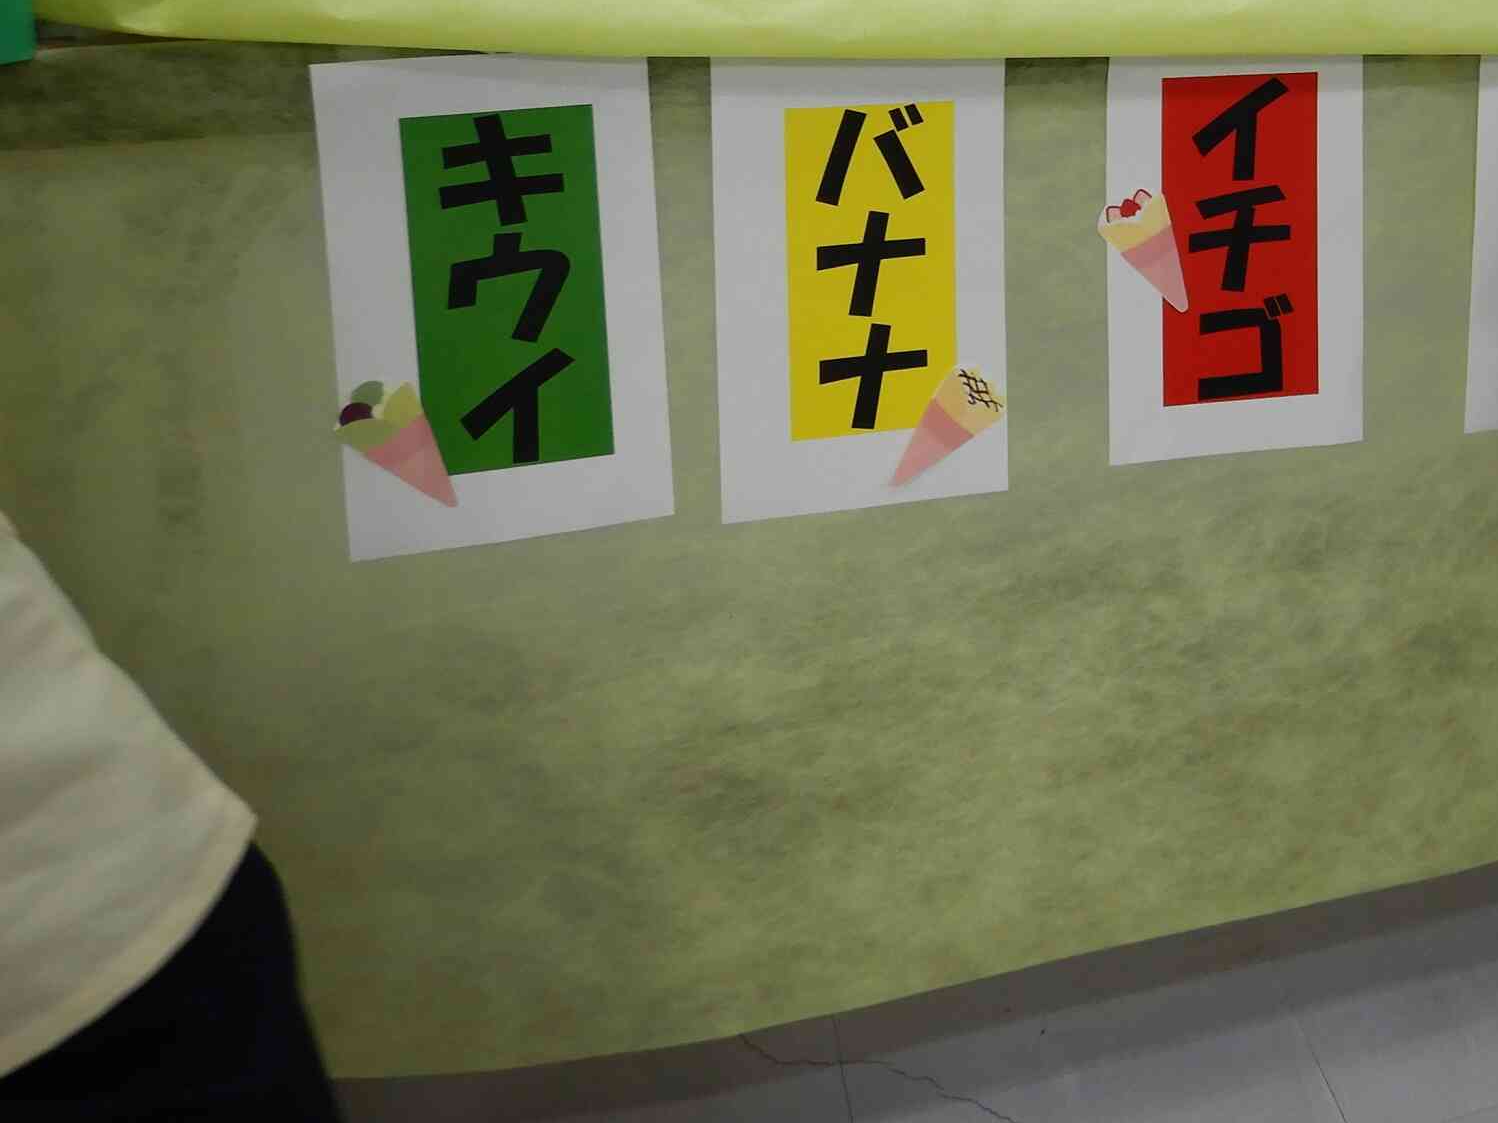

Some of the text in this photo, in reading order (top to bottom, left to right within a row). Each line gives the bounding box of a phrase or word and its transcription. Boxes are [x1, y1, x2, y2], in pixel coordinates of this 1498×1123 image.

[439, 114, 575, 464] キウイ
[816, 104, 928, 430] バナナ
[1189, 78, 1293, 400] イチゴ
